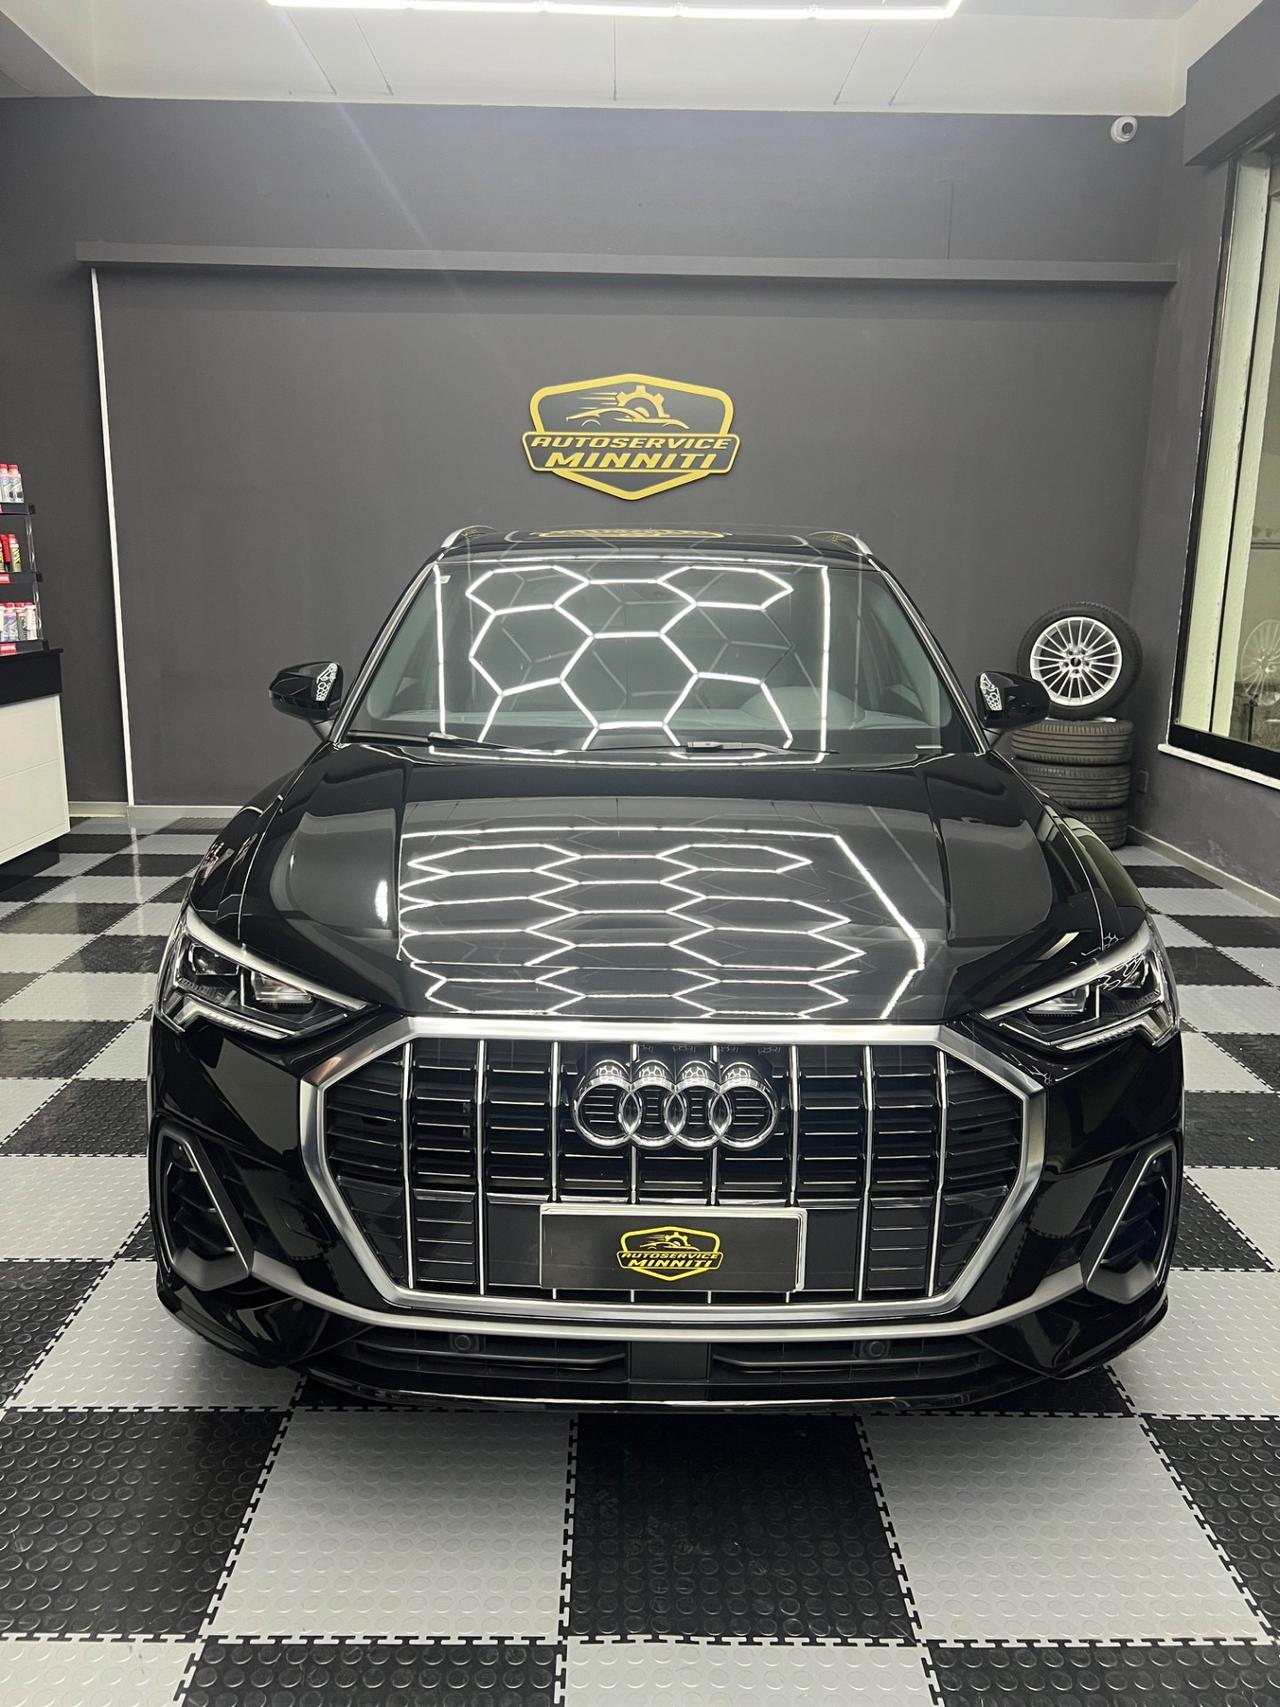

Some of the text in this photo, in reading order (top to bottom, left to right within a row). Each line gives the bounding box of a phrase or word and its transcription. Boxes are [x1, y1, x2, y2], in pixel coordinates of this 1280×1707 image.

[530, 436, 732, 449] AUTOSERVICE
[544, 452, 717, 469] MINNITI
[628, 1259, 713, 1268] MINNITI
